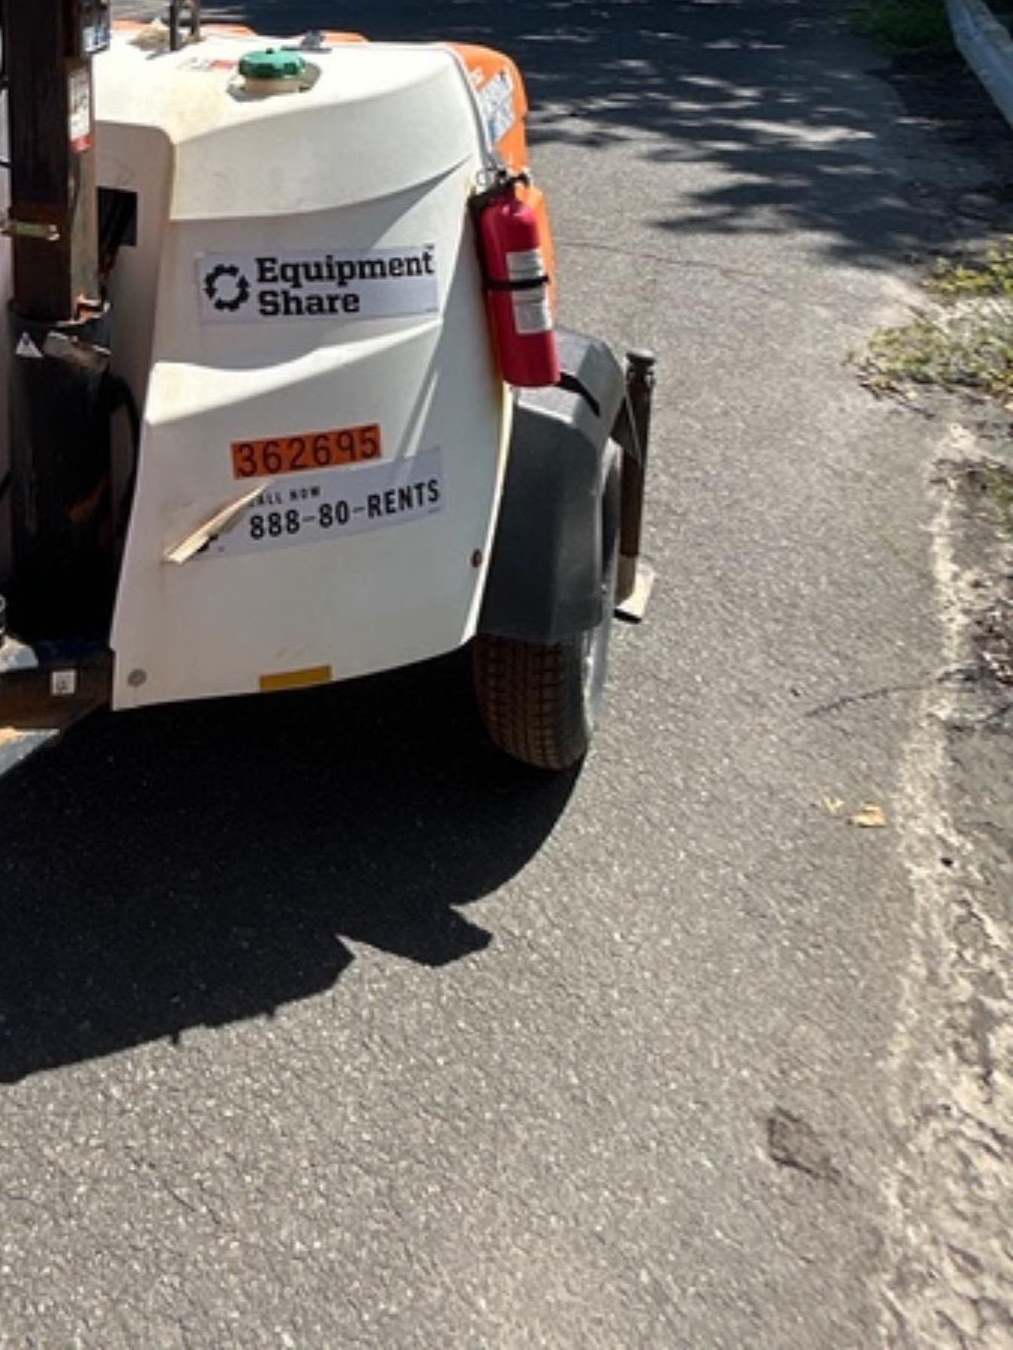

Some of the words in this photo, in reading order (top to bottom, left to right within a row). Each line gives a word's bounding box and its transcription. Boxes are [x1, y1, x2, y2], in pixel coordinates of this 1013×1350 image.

[254, 250, 435, 289] Equipment
[257, 289, 361, 316] Share
[237, 424, 379, 478] 362695
[249, 478, 442, 541] 888-80-RENTS
